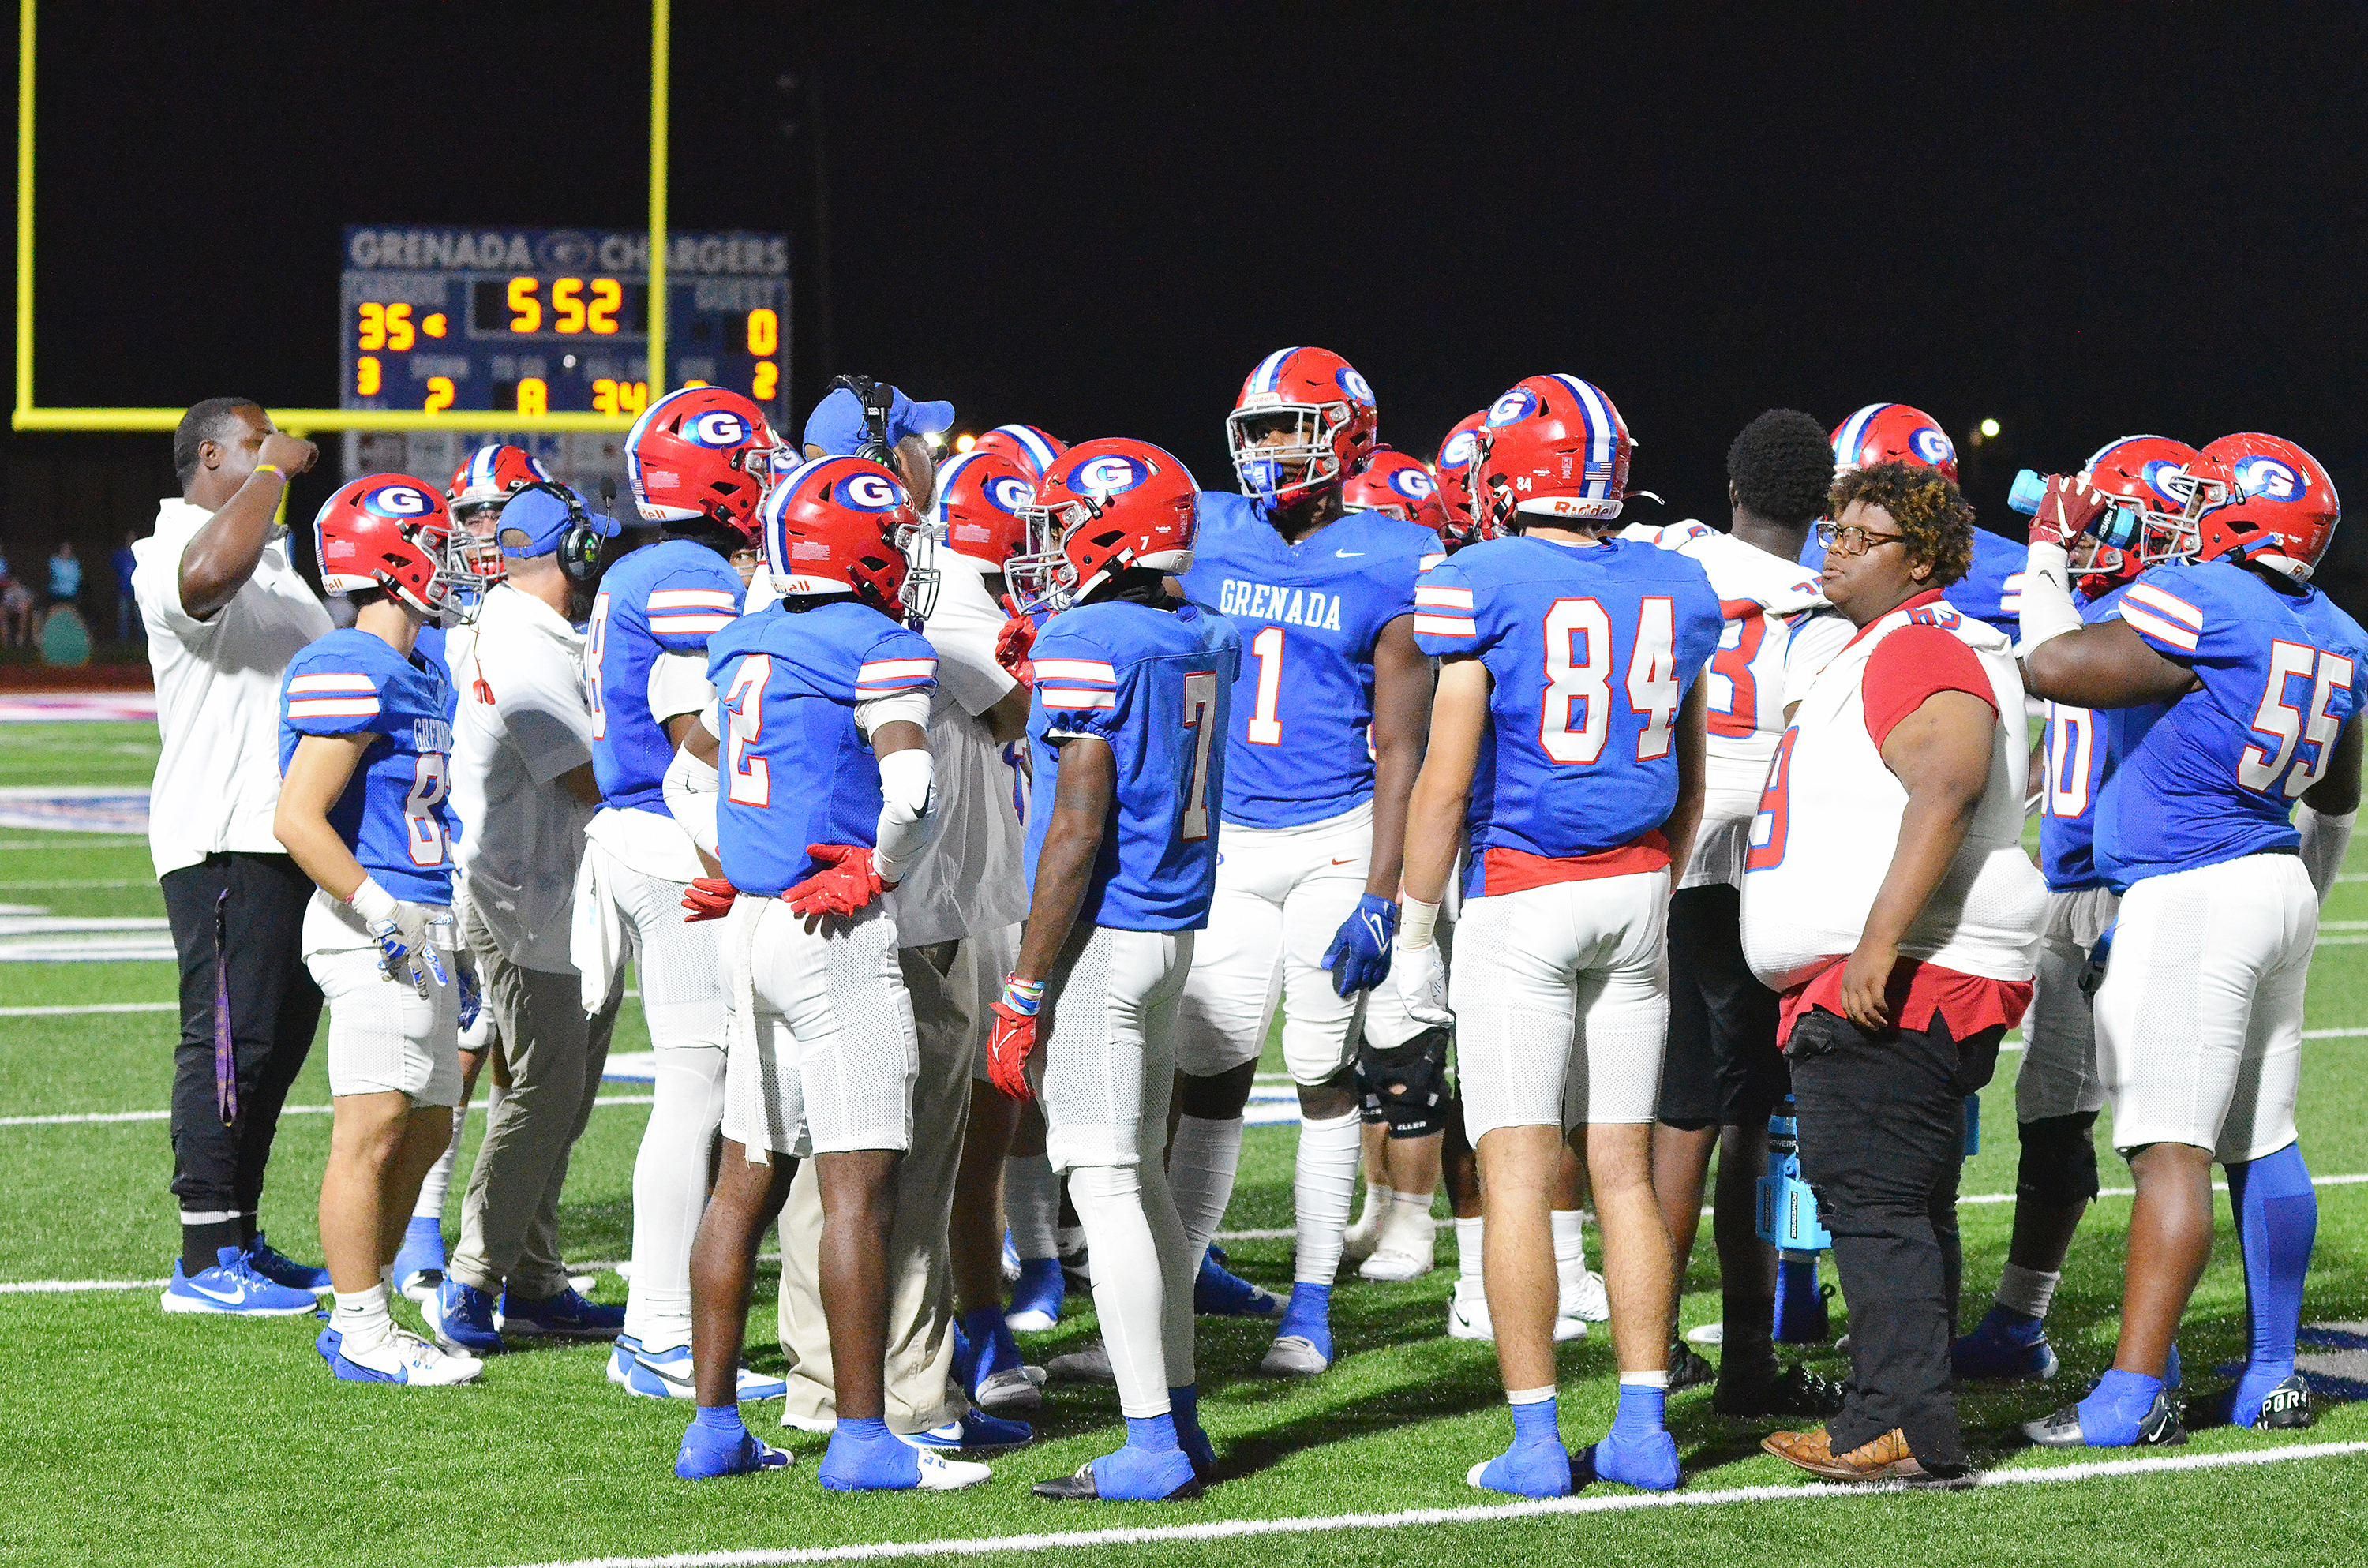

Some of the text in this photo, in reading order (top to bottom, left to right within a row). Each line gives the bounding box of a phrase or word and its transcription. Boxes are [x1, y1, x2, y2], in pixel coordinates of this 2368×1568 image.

[352, 232, 533, 268] GRENADA
[599, 234, 788, 272] CHRGERS
[358, 302, 414, 350] 35
[748, 309, 777, 356] 0
[358, 356, 380, 395] 3
[752, 361, 778, 400] 2
[1247, 395, 1275, 404] Riddell
[1490, 392, 1527, 423] G
[697, 413, 742, 445] G
[1918, 430, 1950, 461] G
[848, 475, 895, 507] G
[1081, 458, 1133, 489] G
[1398, 470, 1431, 497] G
[1516, 476, 1532, 492] 84
[2248, 460, 2295, 497] G
[377, 487, 424, 514] G
[996, 479, 1031, 510] G
[1555, 501, 1618, 518] Riddell
[1140, 535, 1150, 550] 7
[1220, 579, 1341, 631] GRENADA
[1247, 626, 1285, 746] 1
[1538, 595, 1679, 765] 84
[1707, 597, 1767, 739] 3
[724, 654, 772, 809] 2
[2236, 638, 2355, 799] 55
[1182, 670, 1216, 844] 7
[404, 751, 454, 867] 8
